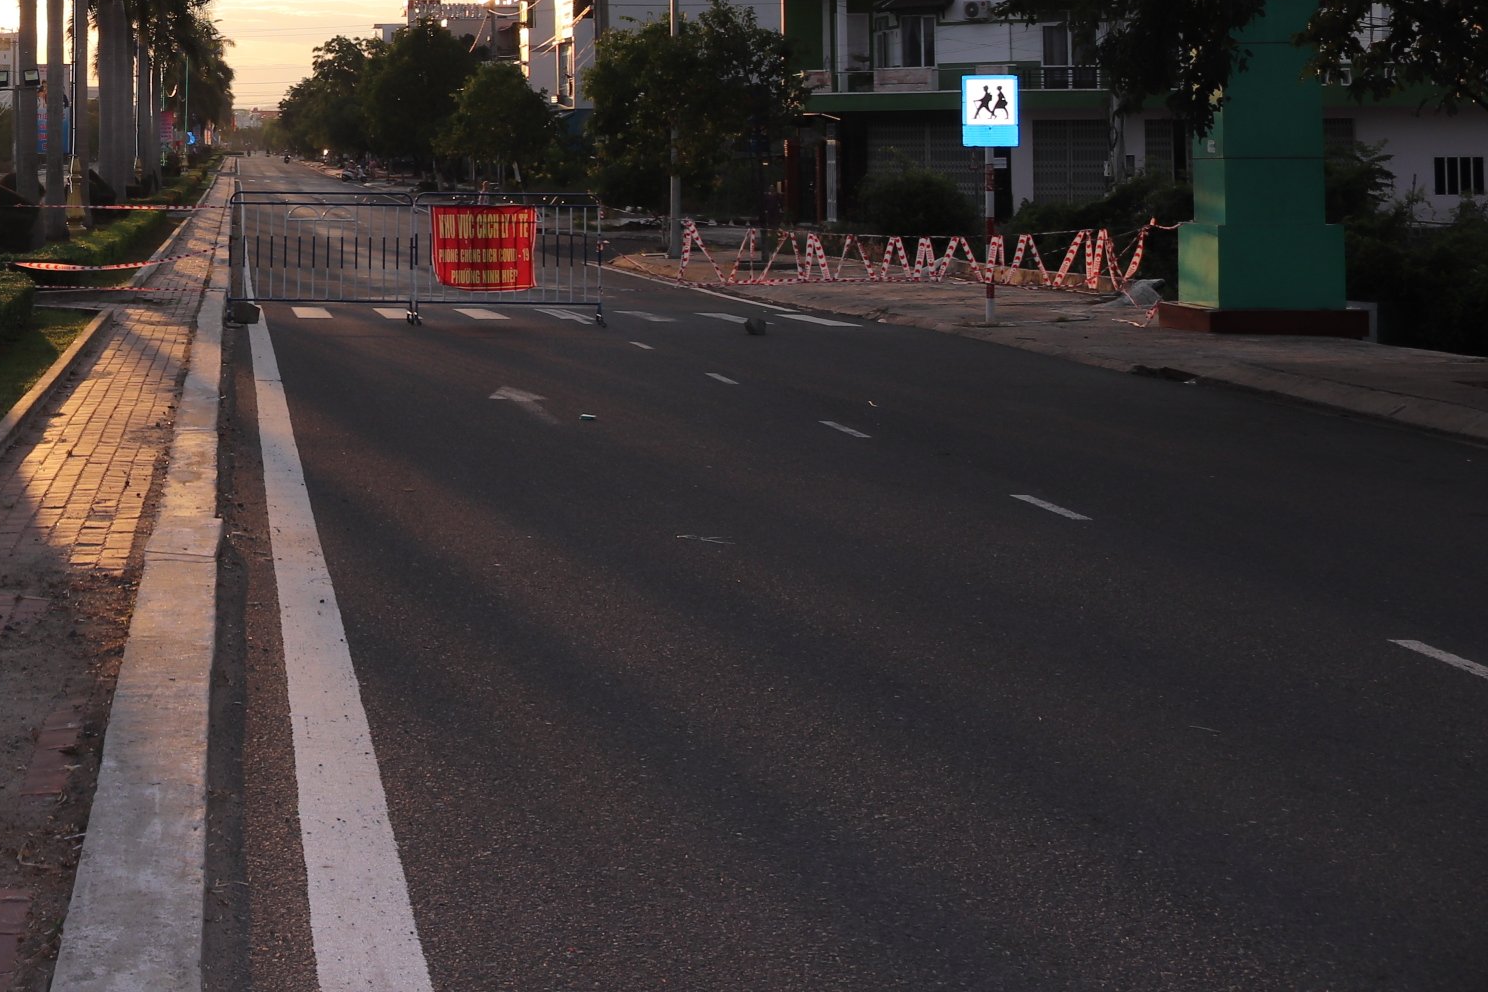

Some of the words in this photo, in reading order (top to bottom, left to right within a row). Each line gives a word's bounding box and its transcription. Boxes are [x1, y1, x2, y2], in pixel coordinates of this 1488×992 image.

[438, 213, 455, 239] KHU
[457, 211, 475, 244] VỰC
[476, 210, 499, 239] CÁCH
[501, 213, 510, 239] LY
[511, 213, 517, 239] Y
[518, 209, 529, 238] TẾ
[522, 247, 530, 262] 19
[482, 269, 500, 284] NINH
